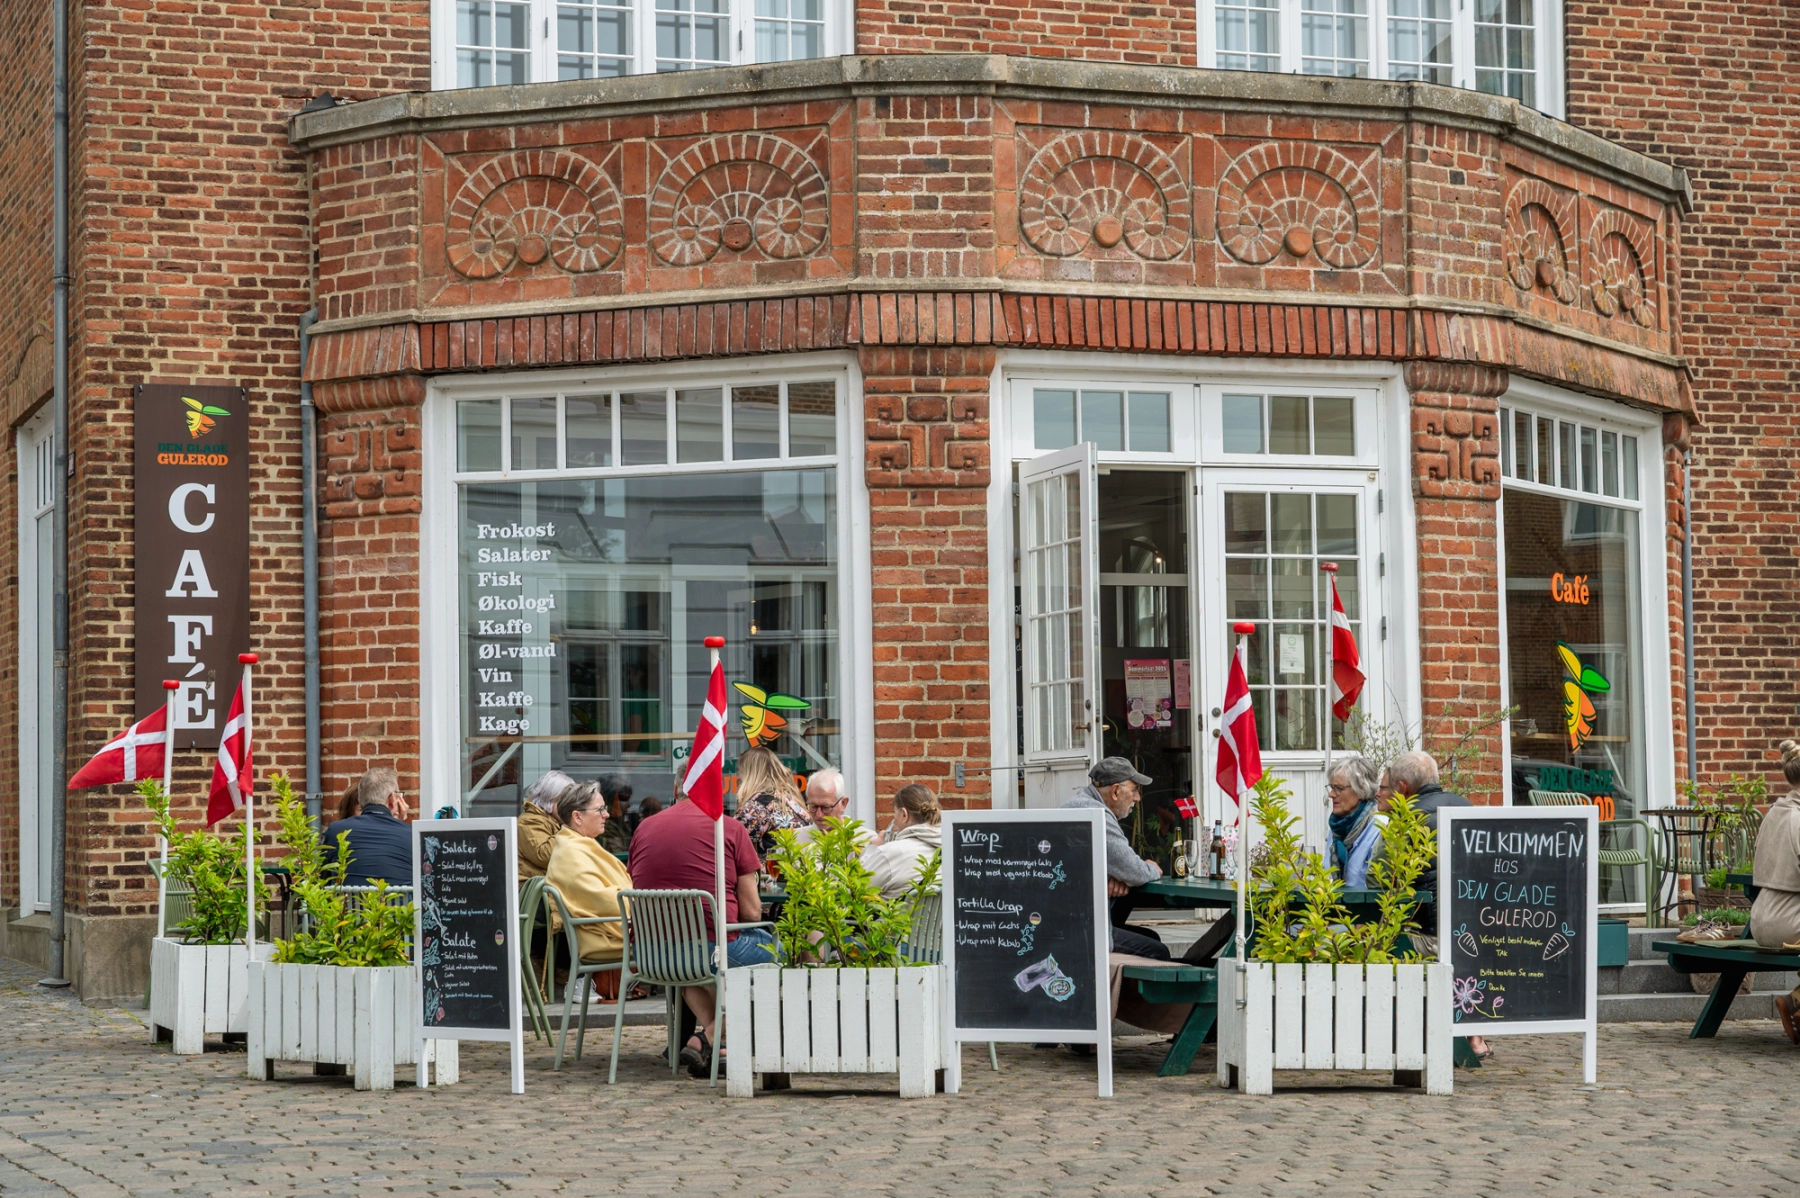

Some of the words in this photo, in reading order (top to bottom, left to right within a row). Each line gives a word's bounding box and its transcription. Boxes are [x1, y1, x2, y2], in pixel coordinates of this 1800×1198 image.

[157, 443, 183, 453] DEN
[186, 443, 229, 454] GLADE
[157, 453, 229, 467] GULEROD
[477, 522, 556, 539] Frokost
[478, 547, 551, 563] Salater
[477, 571, 522, 587] Fisk
[1551, 572, 1590, 606] Café
[165, 482, 218, 729] CAFÉ
[478, 594, 556, 613] Økologi
[478, 619, 532, 635] Kaffe
[479, 642, 557, 659] Øl-vand
[478, 668, 513, 683] Vin
[479, 691, 533, 707] Kaffe
[479, 716, 530, 735] Kage
[1540, 767, 1569, 791] DEN
[1571, 768, 1615, 793] GLADE
[442, 840, 477, 854] Salater
[958, 829, 1000, 853] Wrap
[1461, 828, 1584, 858] VELKOMMEN
[963, 855, 983, 866] Wrap
[1493, 858, 1519, 875] HOS
[964, 868, 982, 879] Wrap
[985, 869, 1001, 877] med
[1457, 879, 1489, 900] DEN
[1494, 881, 1556, 906] GLADE
[1480, 906, 1557, 929] GULEROD
[958, 920, 980, 932] Wrap
[982, 921, 997, 930] mit
[442, 931, 477, 949] Salate
[958, 934, 979, 948] Wrap
[980, 937, 996, 945] mit
[1518, 967, 1527, 977] Sie
